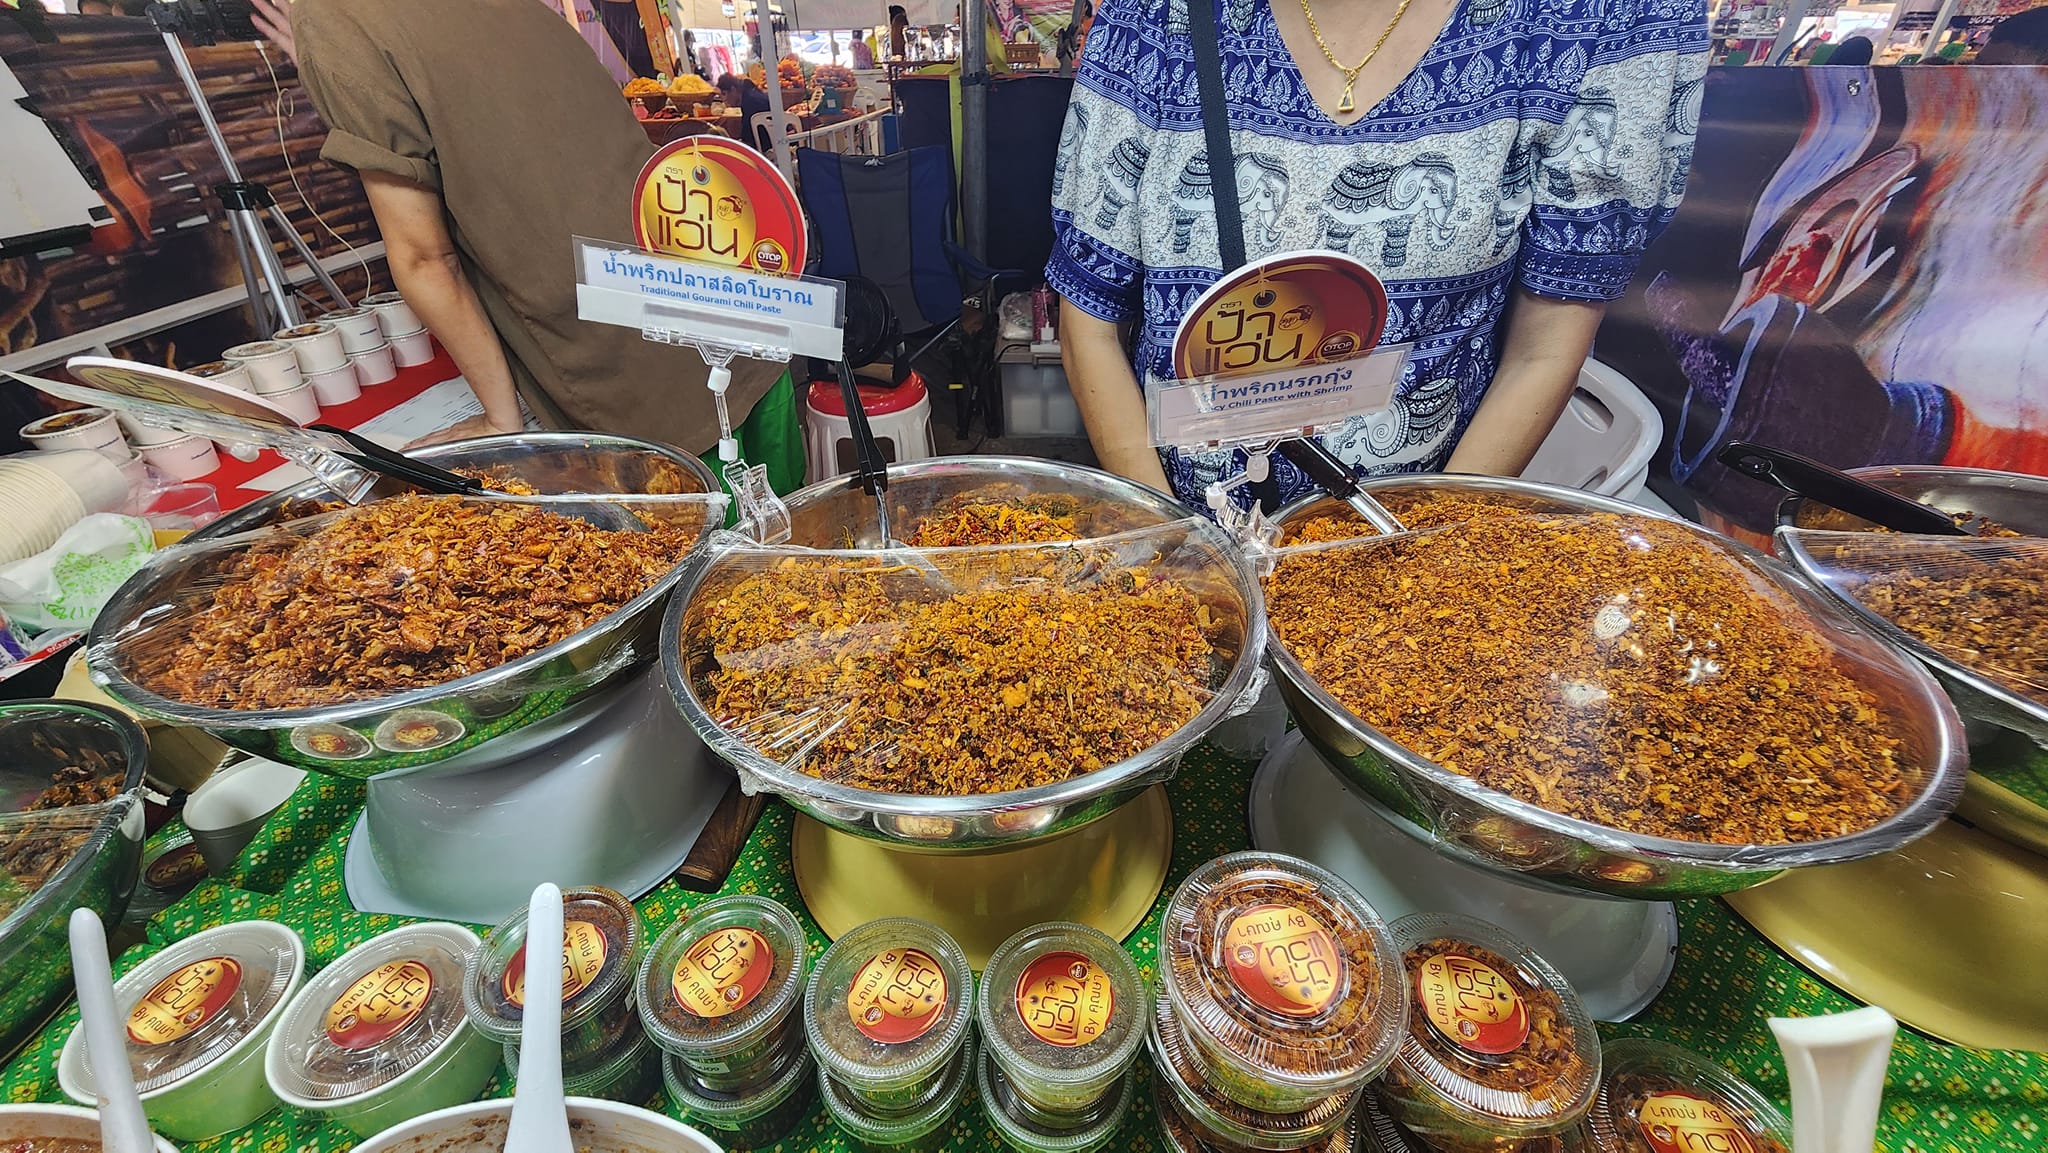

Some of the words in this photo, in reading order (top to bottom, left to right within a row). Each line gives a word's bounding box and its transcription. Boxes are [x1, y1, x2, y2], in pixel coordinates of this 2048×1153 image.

[666, 166, 684, 176] ตรา
[656, 174, 713, 221] ป้า
[657, 213, 738, 258] แว่น
[757, 251, 782, 262] OTOP
[603, 252, 814, 306] น้ำพริกปลาสลิดโบราณ
[640, 284, 690, 300] Traditional
[692, 293, 731, 306] Gourami
[734, 299, 754, 310] Chili
[756, 303, 782, 314] Paste
[1220, 301, 1242, 309] ตรา
[1206, 309, 1276, 345] ป้า
[1205, 333, 1303, 372] แว่น
[1323, 341, 1352, 352] OTOP
[1229, 399, 1252, 409] Chili
[1254, 395, 1285, 405] Paste
[1287, 390, 1311, 400] with
[1313, 384, 1353, 396] Shrimp
[1288, 914, 1307, 928] By
[711, 934, 739, 963] ป้า
[880, 952, 897, 969] By
[1265, 936, 1323, 968] แว่น
[175, 967, 204, 993] ป้า
[377, 965, 395, 979] By
[585, 958, 599, 975] By
[677, 966, 692, 983] By
[694, 946, 733, 985] แว่น
[1289, 960, 1331, 985] ป้า
[1428, 962, 1442, 979] By
[363, 969, 414, 1011] แว่น
[387, 977, 425, 1006] ป้า
[882, 959, 921, 1004] แว่น
[906, 967, 938, 999] ป้า
[1451, 963, 1480, 1011] แว่น
[1472, 968, 1497, 1000] ป้า
[152, 983, 196, 1013] แว่น
[1033, 995, 1060, 1029] ป้า
[1055, 985, 1080, 1034] แว่น
[133, 1006, 150, 1023] By
[1083, 1018, 1099, 1035] By
[1702, 1106, 1723, 1123] By
